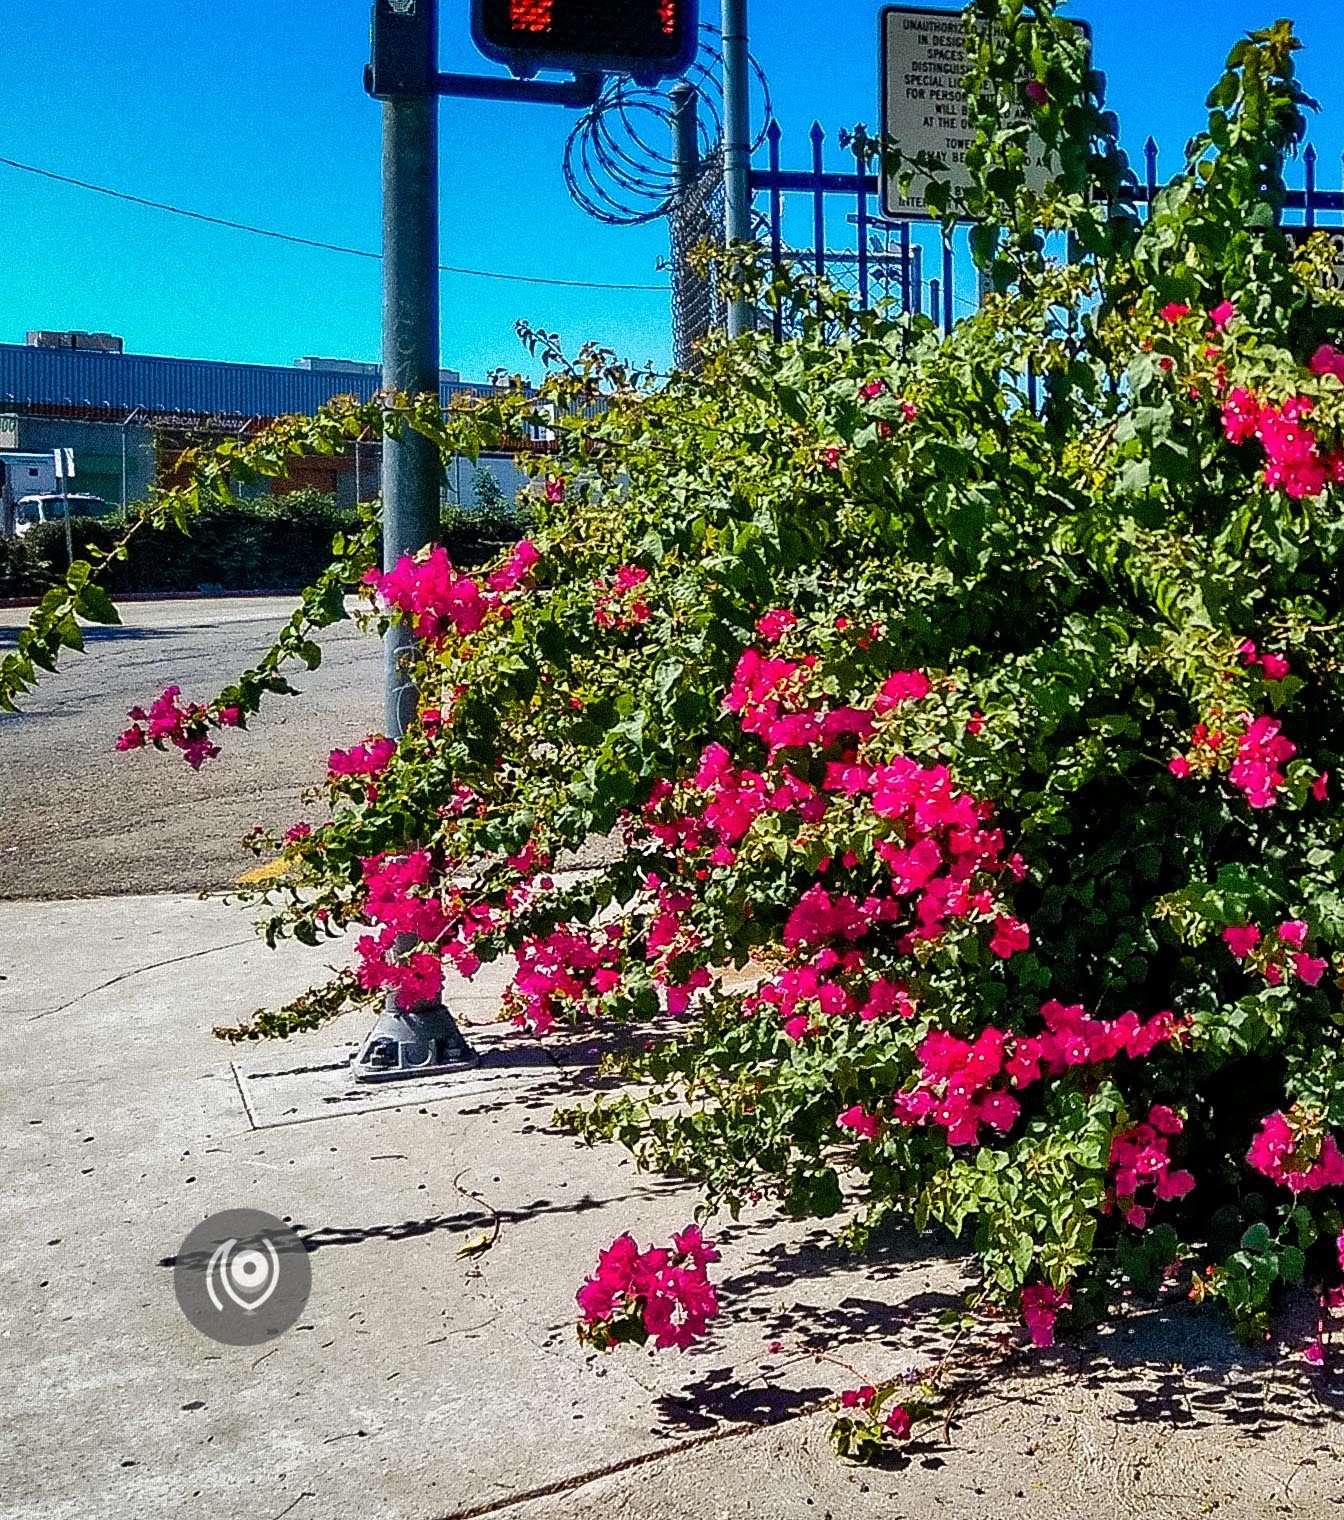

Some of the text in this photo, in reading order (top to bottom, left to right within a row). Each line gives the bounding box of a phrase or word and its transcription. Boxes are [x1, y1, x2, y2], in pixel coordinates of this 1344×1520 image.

[918, 34, 929, 45] IN
[927, 47, 965, 61] SPACES
[904, 73, 944, 87] SPECIAL
[905, 87, 964, 102] FOR PERSO
[935, 103, 957, 116] WILL
[923, 116, 934, 128] AT
[938, 117, 957, 129] THE
[952, 152, 966, 164] BE
